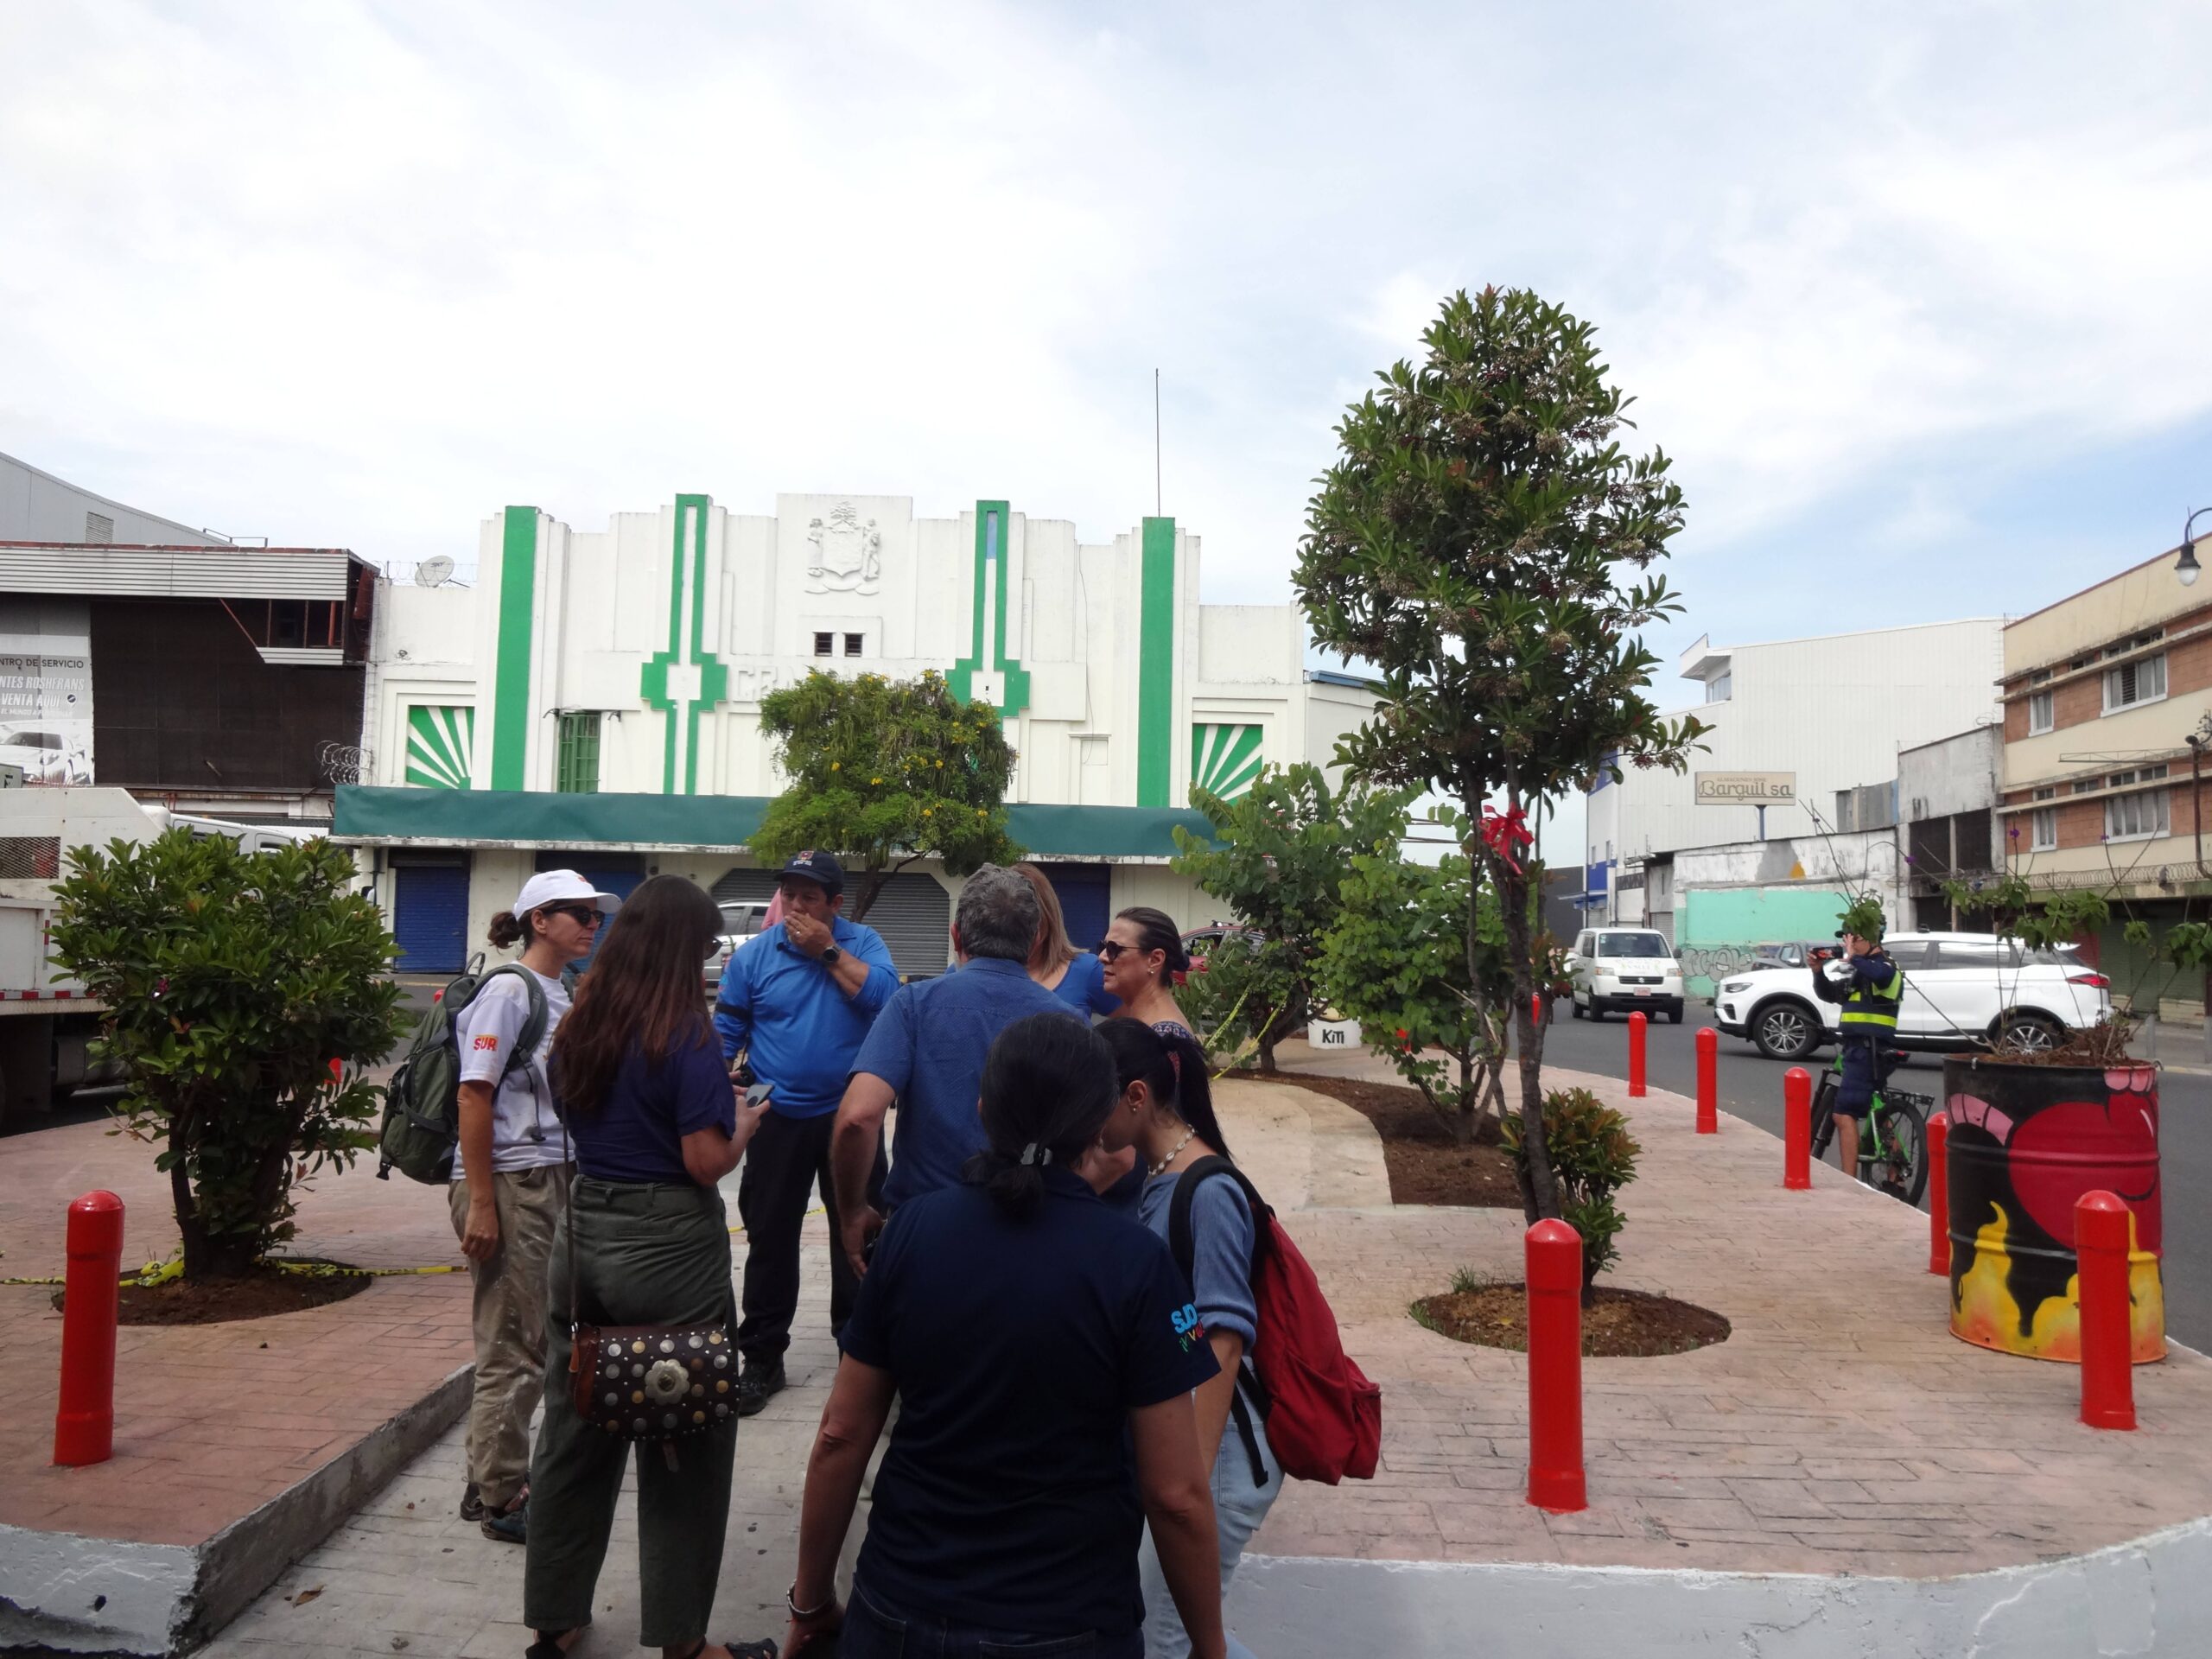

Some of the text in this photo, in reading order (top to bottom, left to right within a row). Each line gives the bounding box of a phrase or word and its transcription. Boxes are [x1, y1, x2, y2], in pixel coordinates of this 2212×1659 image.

[26, 658, 39, 667] DE
[41, 659, 84, 669] SERVICIO
[1, 693, 33, 706] VENTA
[1698, 780, 1767, 801] Barguil
[473, 1036, 497, 1052] SUR
